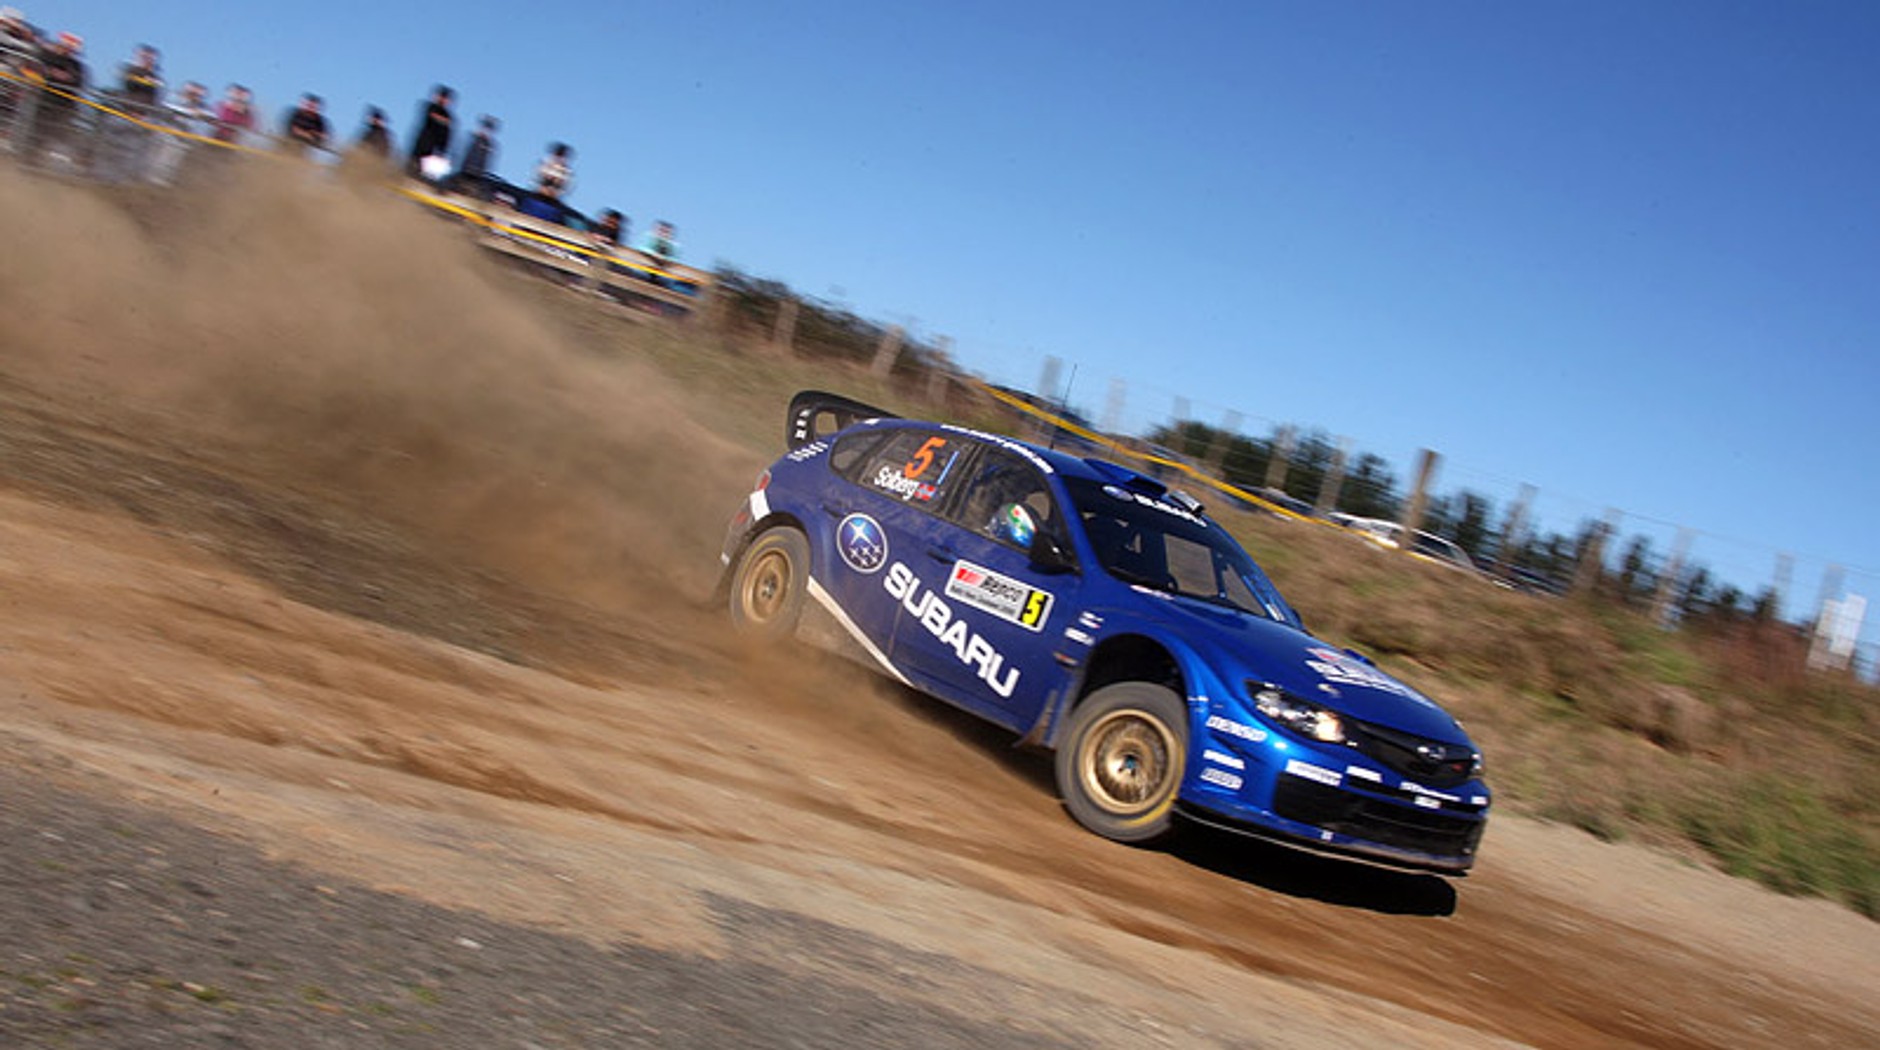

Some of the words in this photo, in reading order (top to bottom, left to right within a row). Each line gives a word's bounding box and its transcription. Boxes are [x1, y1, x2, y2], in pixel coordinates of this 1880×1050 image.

[905, 436, 946, 478] 5
[874, 466, 920, 501] Solberg
[1022, 591, 1045, 625] 5
[884, 562, 1020, 696] SUBARU
